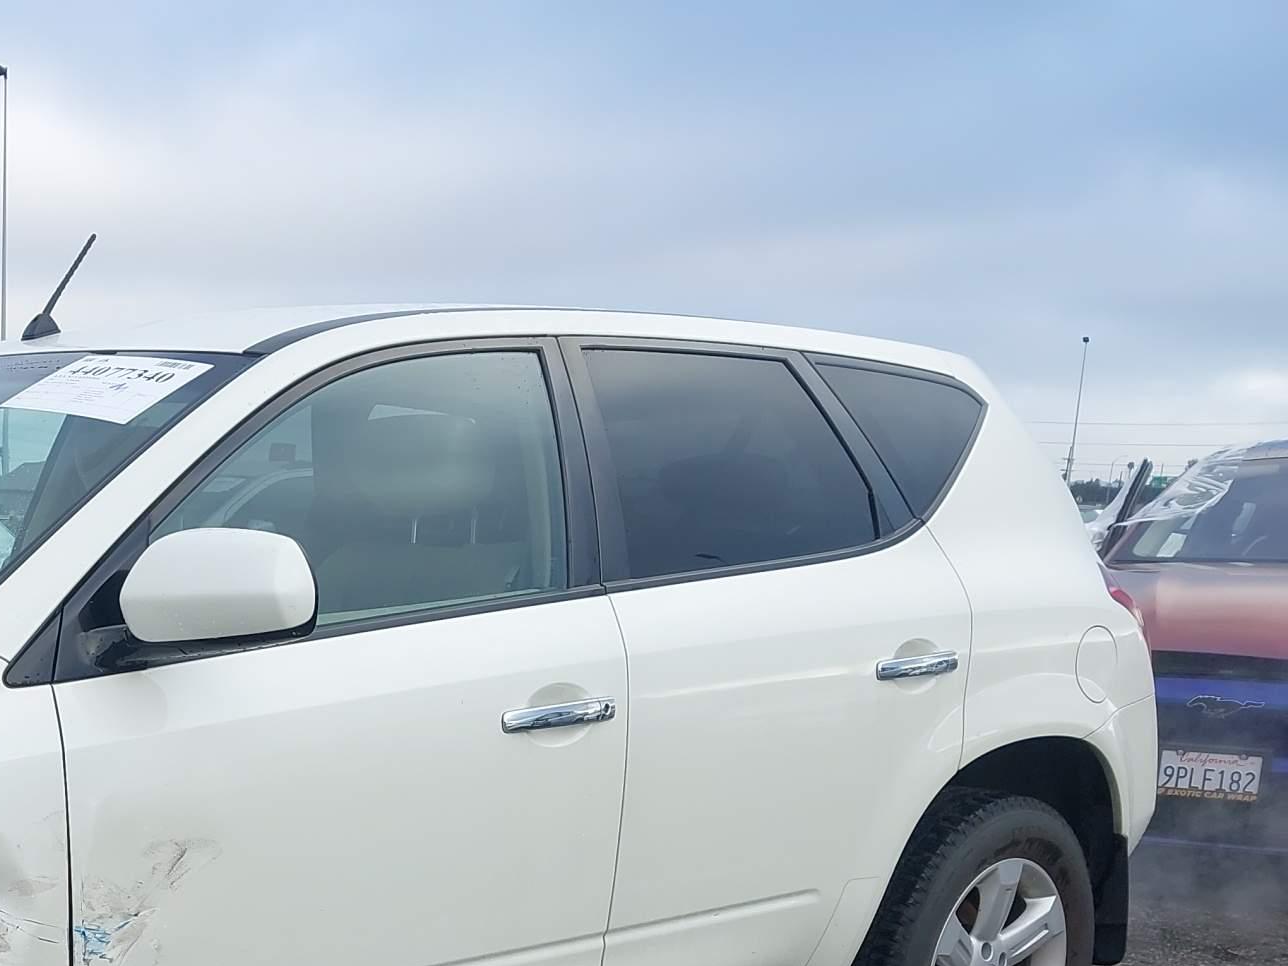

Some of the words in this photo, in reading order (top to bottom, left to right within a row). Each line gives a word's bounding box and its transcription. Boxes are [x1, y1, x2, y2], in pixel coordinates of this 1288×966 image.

[69, 365, 176, 384] 44077340
[1178, 751, 1245, 767] California
[1163, 765, 1256, 794] 9PLF182
[1204, 791, 1225, 799] CAR
